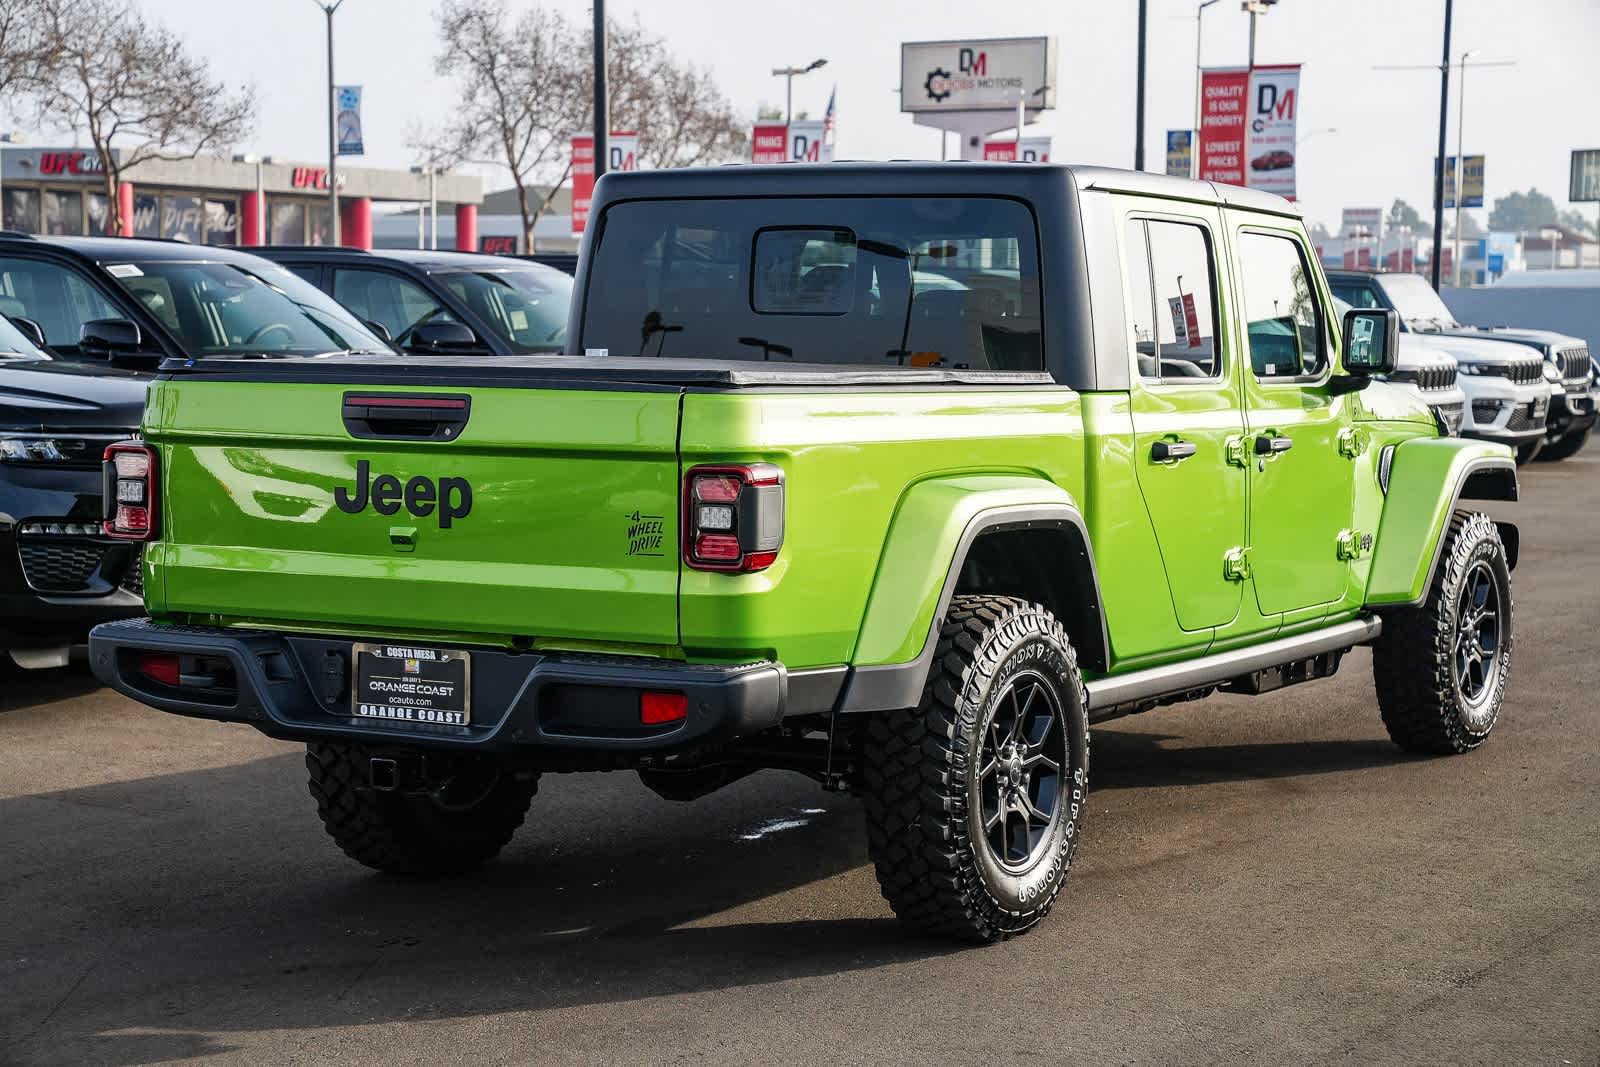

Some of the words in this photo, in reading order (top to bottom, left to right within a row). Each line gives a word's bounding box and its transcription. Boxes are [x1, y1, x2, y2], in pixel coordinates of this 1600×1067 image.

[977, 77, 1023, 89] MOTORS
[1206, 85, 1244, 98] QUALITY
[1208, 101, 1218, 113] IS
[1219, 100, 1239, 112] OUR
[1258, 84, 1295, 121] DM
[1203, 115, 1243, 127] PRIORITY
[1205, 141, 1240, 154] LOWEST
[40, 152, 84, 174] UFC
[1207, 156, 1238, 168] PRICES
[291, 167, 328, 189] UFC
[334, 460, 473, 529] Jeep
[631, 510, 641, 522] 4
[628, 521, 664, 539] WHEEL
[629, 535, 664, 556] DRIVE
[387, 647, 413, 659] COSTA
[413, 649, 436, 660] MESA
[369, 681, 416, 693] ORANGE
[416, 685, 454, 696] COAST
[389, 696, 432, 706] ocauto.com
[360, 704, 412, 719] ORANGE
[418, 710, 462, 723] COAST
